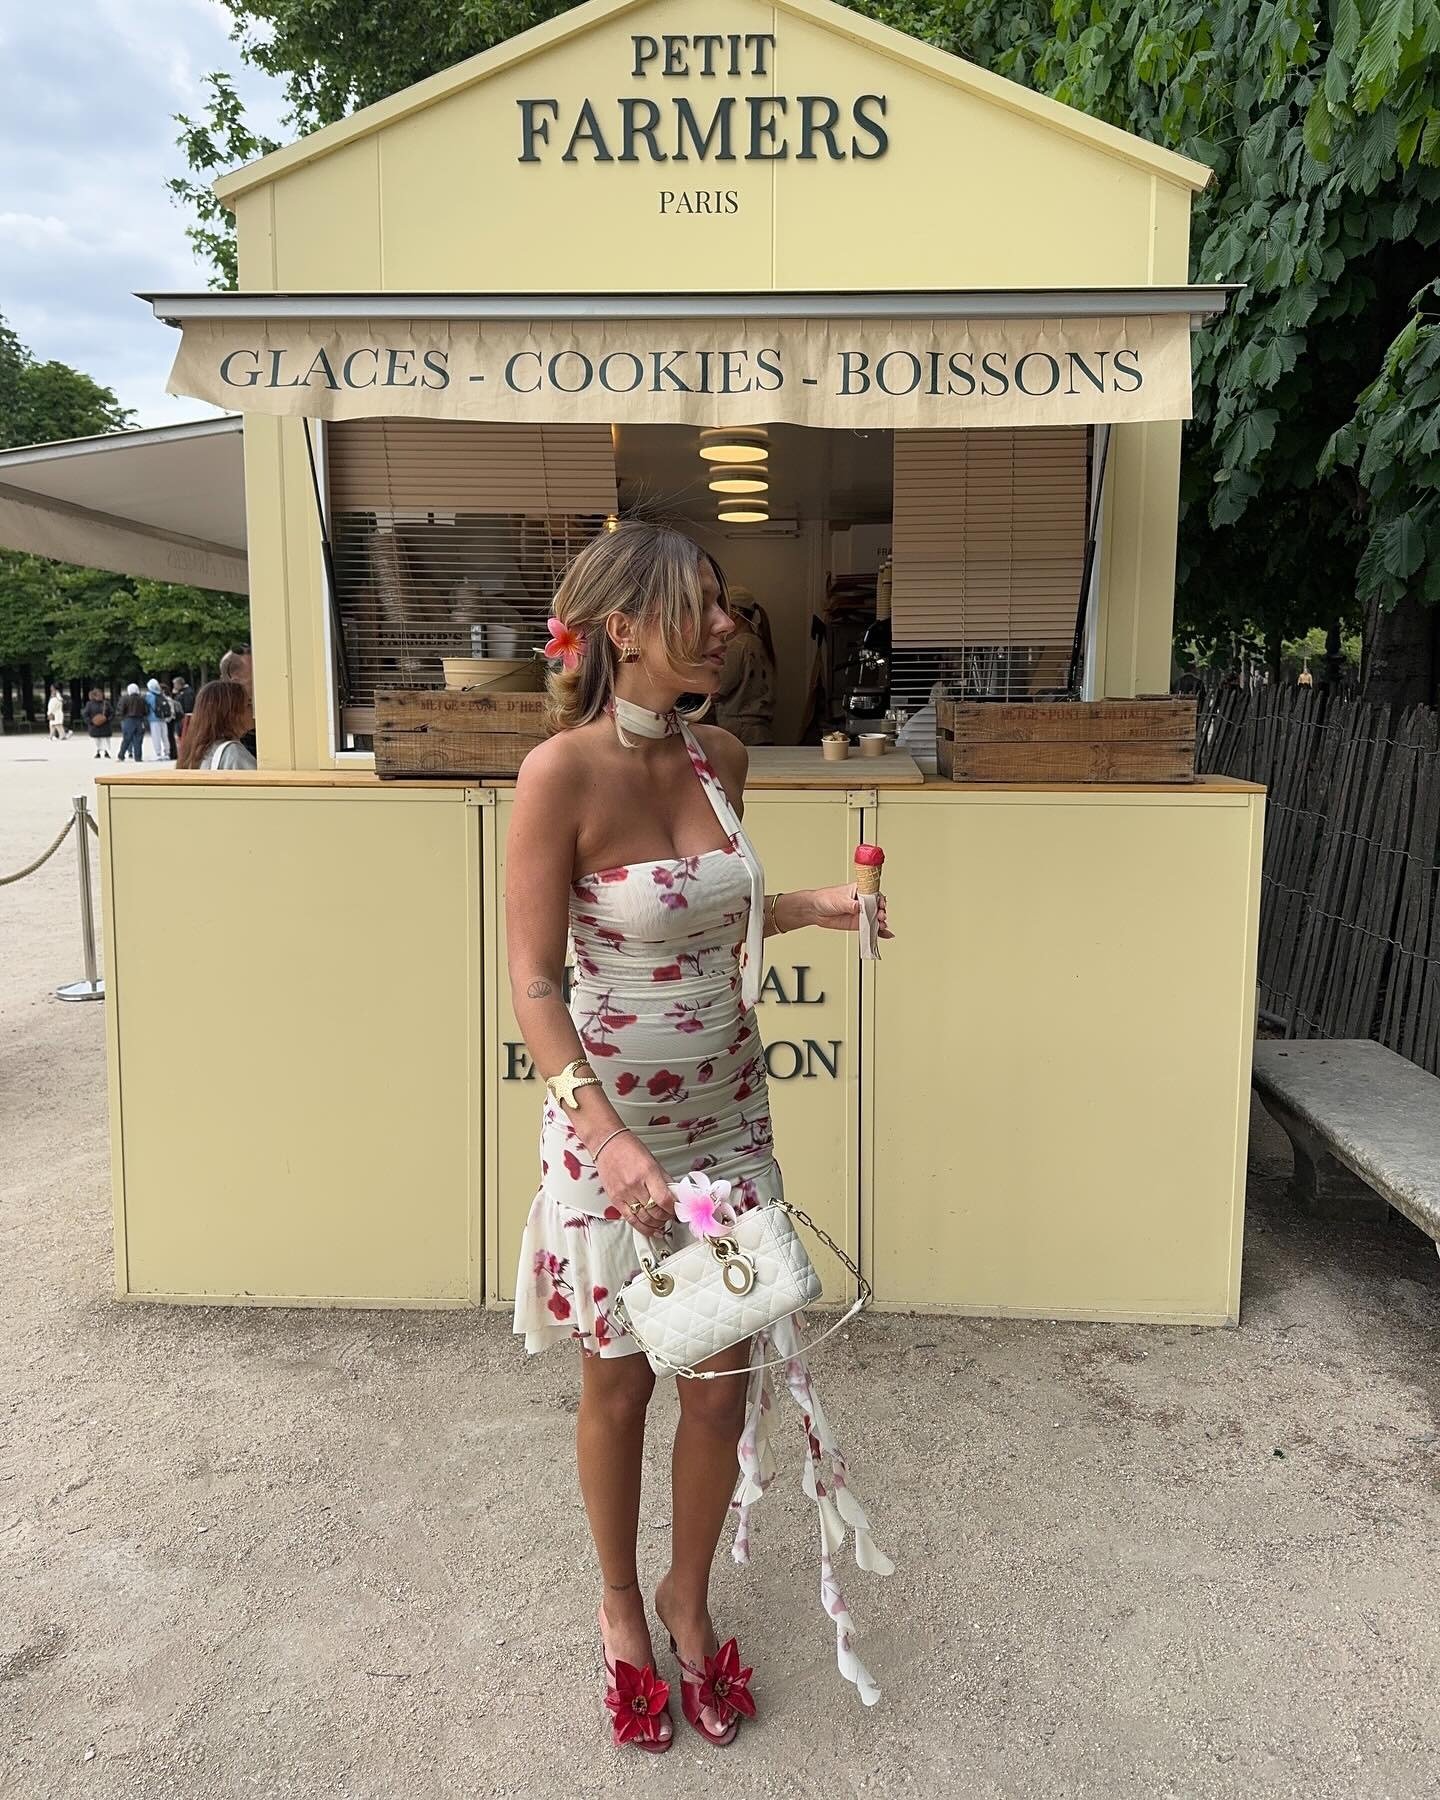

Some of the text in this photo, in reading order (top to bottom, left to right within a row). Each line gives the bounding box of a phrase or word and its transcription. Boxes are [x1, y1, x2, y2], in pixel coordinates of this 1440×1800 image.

[631, 34, 776, 77] PETIT
[516, 94, 890, 162] FARMERS
[658, 190, 740, 214] PARIS
[219, 345, 451, 391] GLACES
[504, 348, 785, 393] COOKIES
[836, 348, 1144, 397] BOISSONS
